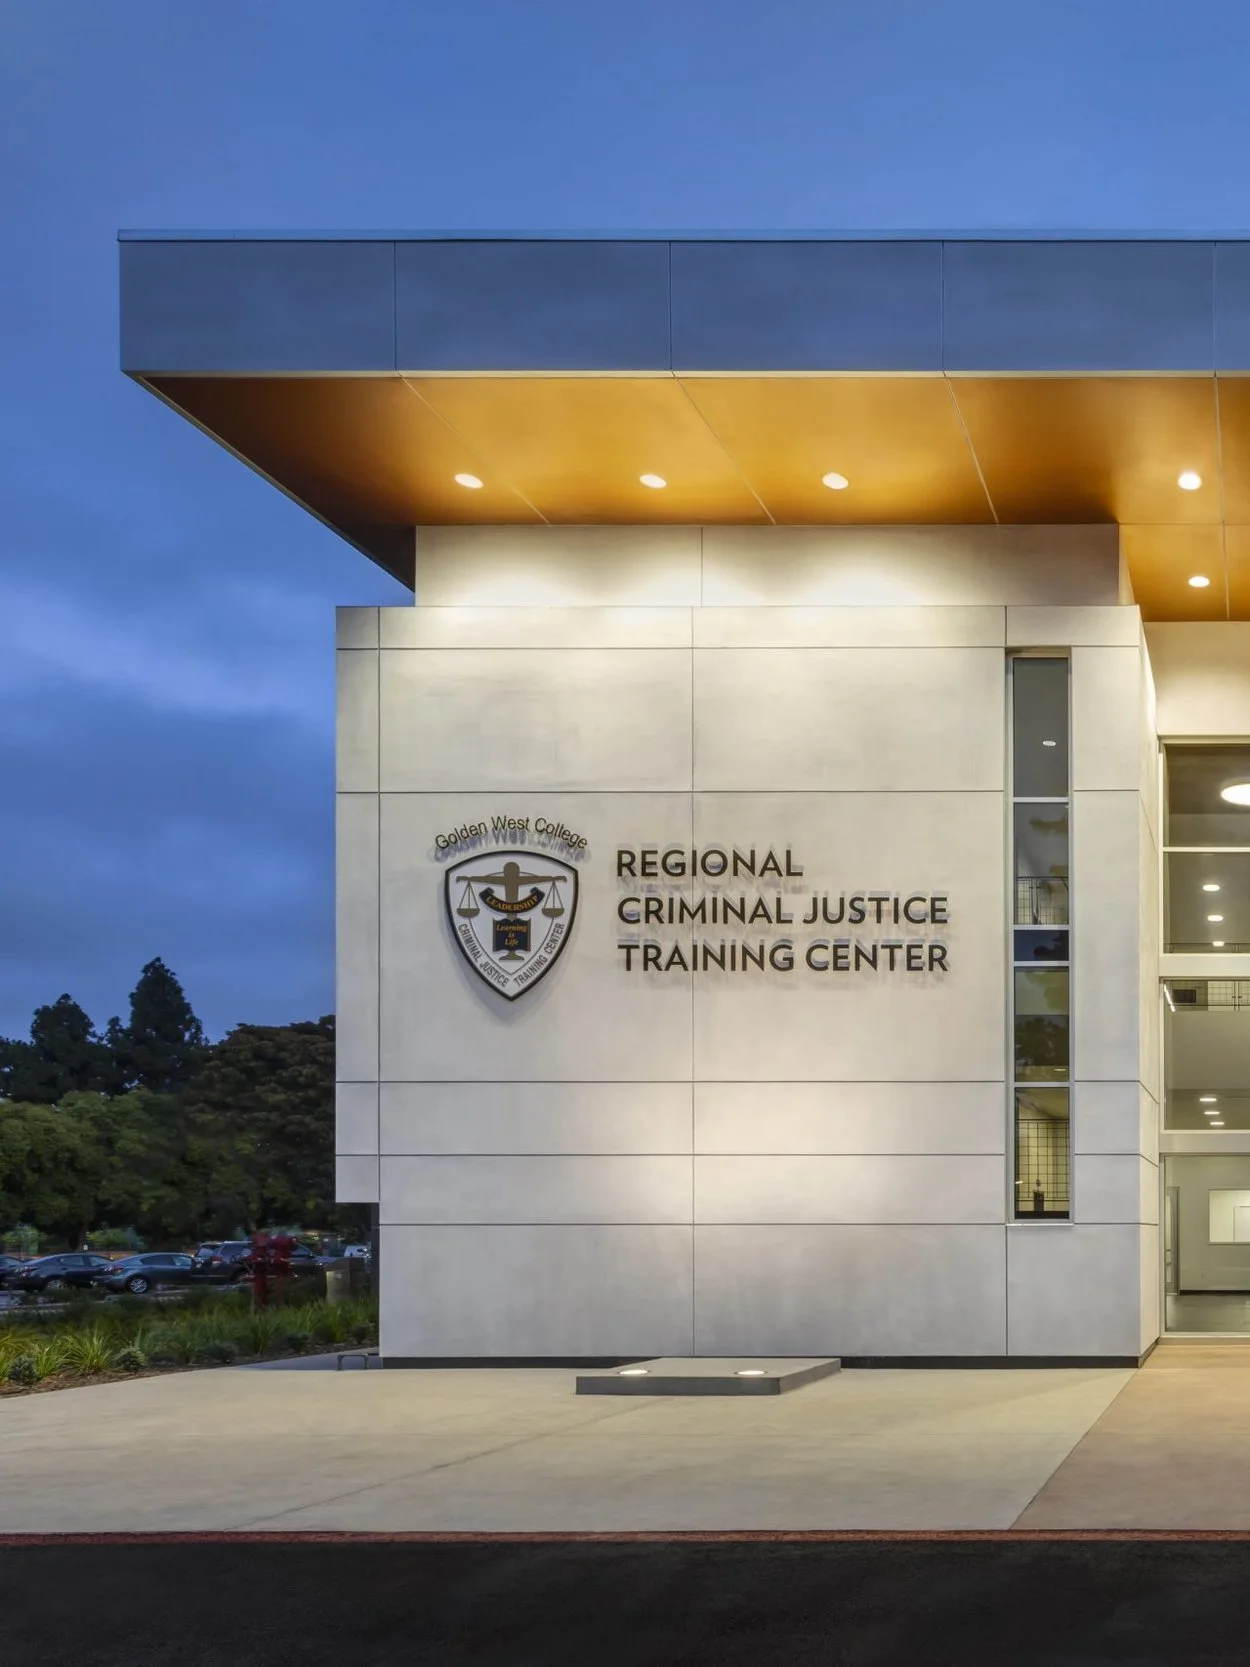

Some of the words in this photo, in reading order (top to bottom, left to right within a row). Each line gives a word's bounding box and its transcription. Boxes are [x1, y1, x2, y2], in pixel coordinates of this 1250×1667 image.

[435, 822, 487, 849] Golden
[491, 815, 530, 831] West
[534, 817, 588, 850] College
[617, 850, 803, 877] REGIONAL
[486, 895, 538, 910] LEADERSHIP
[618, 897, 793, 924] CRIMINAL
[802, 896, 948, 924] JUSTICE
[496, 924, 528, 933] Learning
[504, 938, 519, 946] Life
[458, 923, 483, 961] CRIMINAL
[480, 960, 510, 987] JUSTICE
[513, 955, 548, 987] TRAINING
[543, 922, 565, 954] CENTER
[617, 944, 794, 971] TRAINING
[806, 944, 948, 971] CENTER
